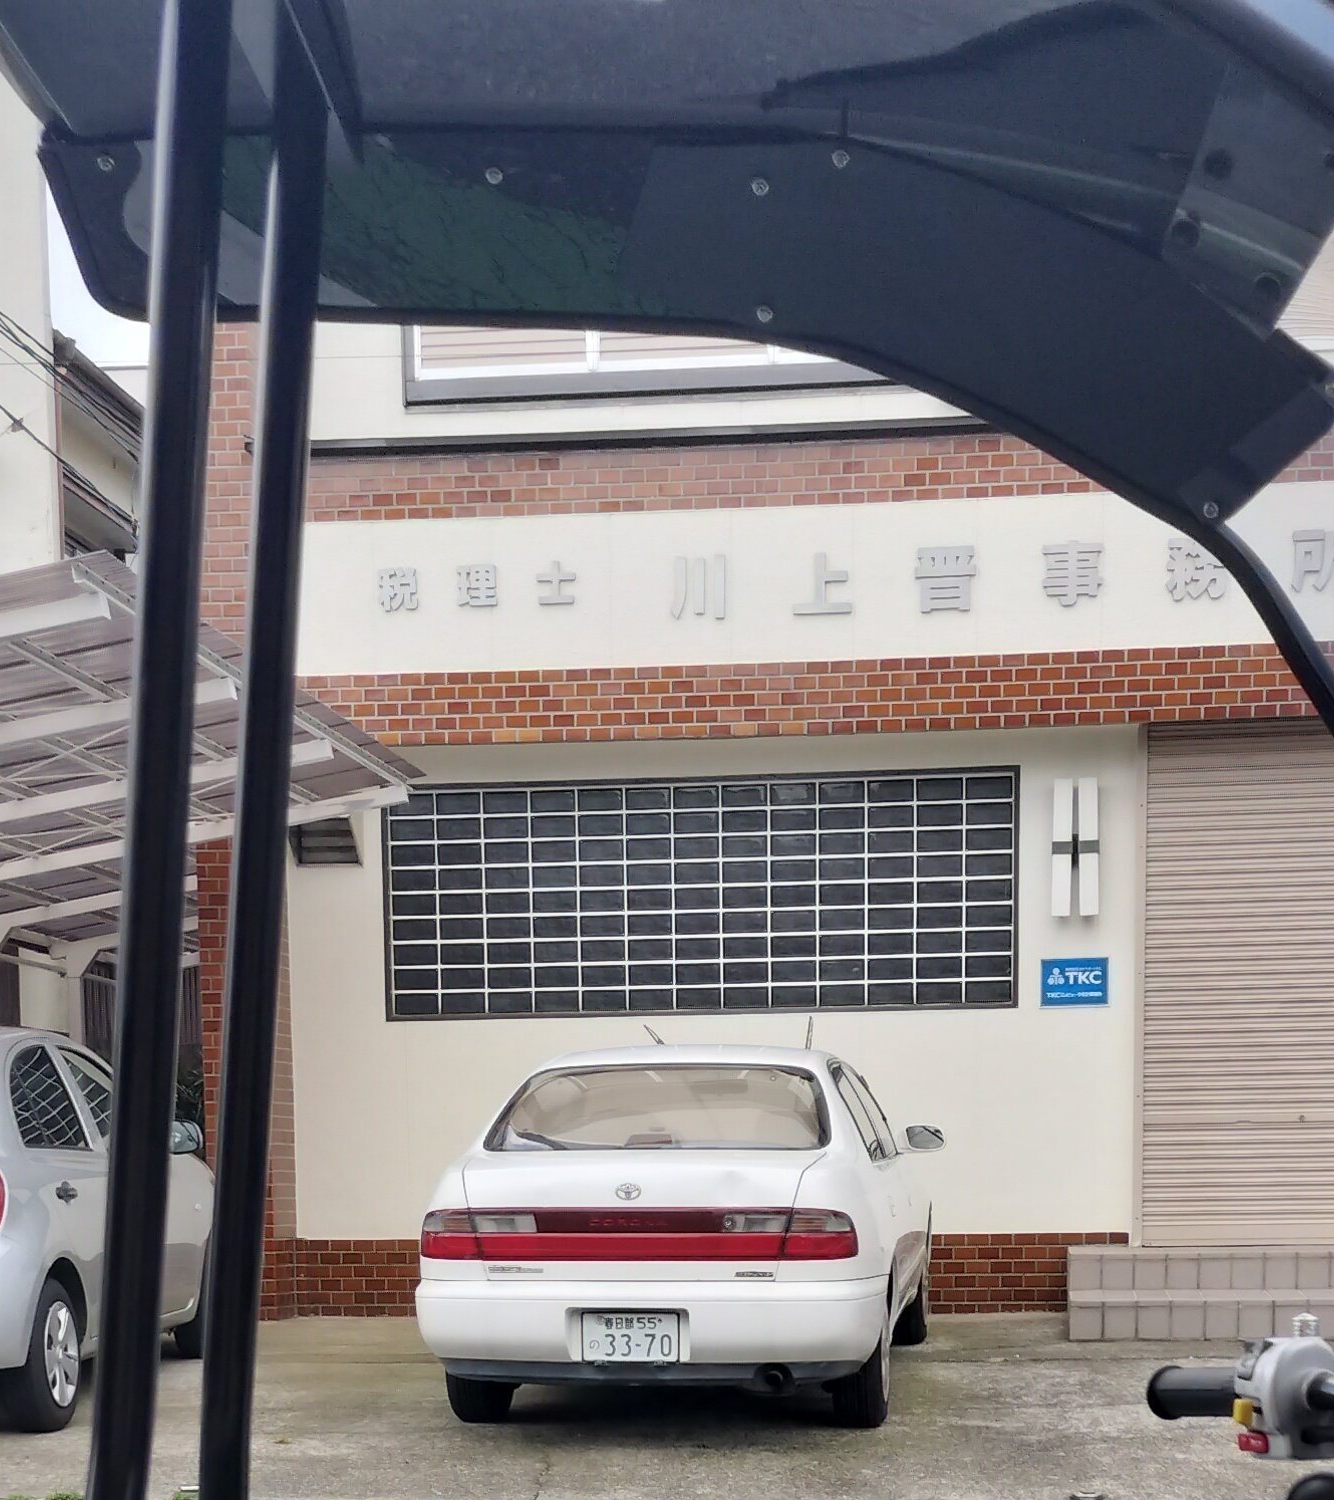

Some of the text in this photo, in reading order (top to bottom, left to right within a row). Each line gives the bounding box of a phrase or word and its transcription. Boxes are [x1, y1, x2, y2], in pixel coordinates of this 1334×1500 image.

[378, 560, 577, 612] 税理士
[1064, 970, 1103, 985] TKC
[604, 1317, 634, 1330] 春日部
[589, 1333, 673, 1358] の 33-70
